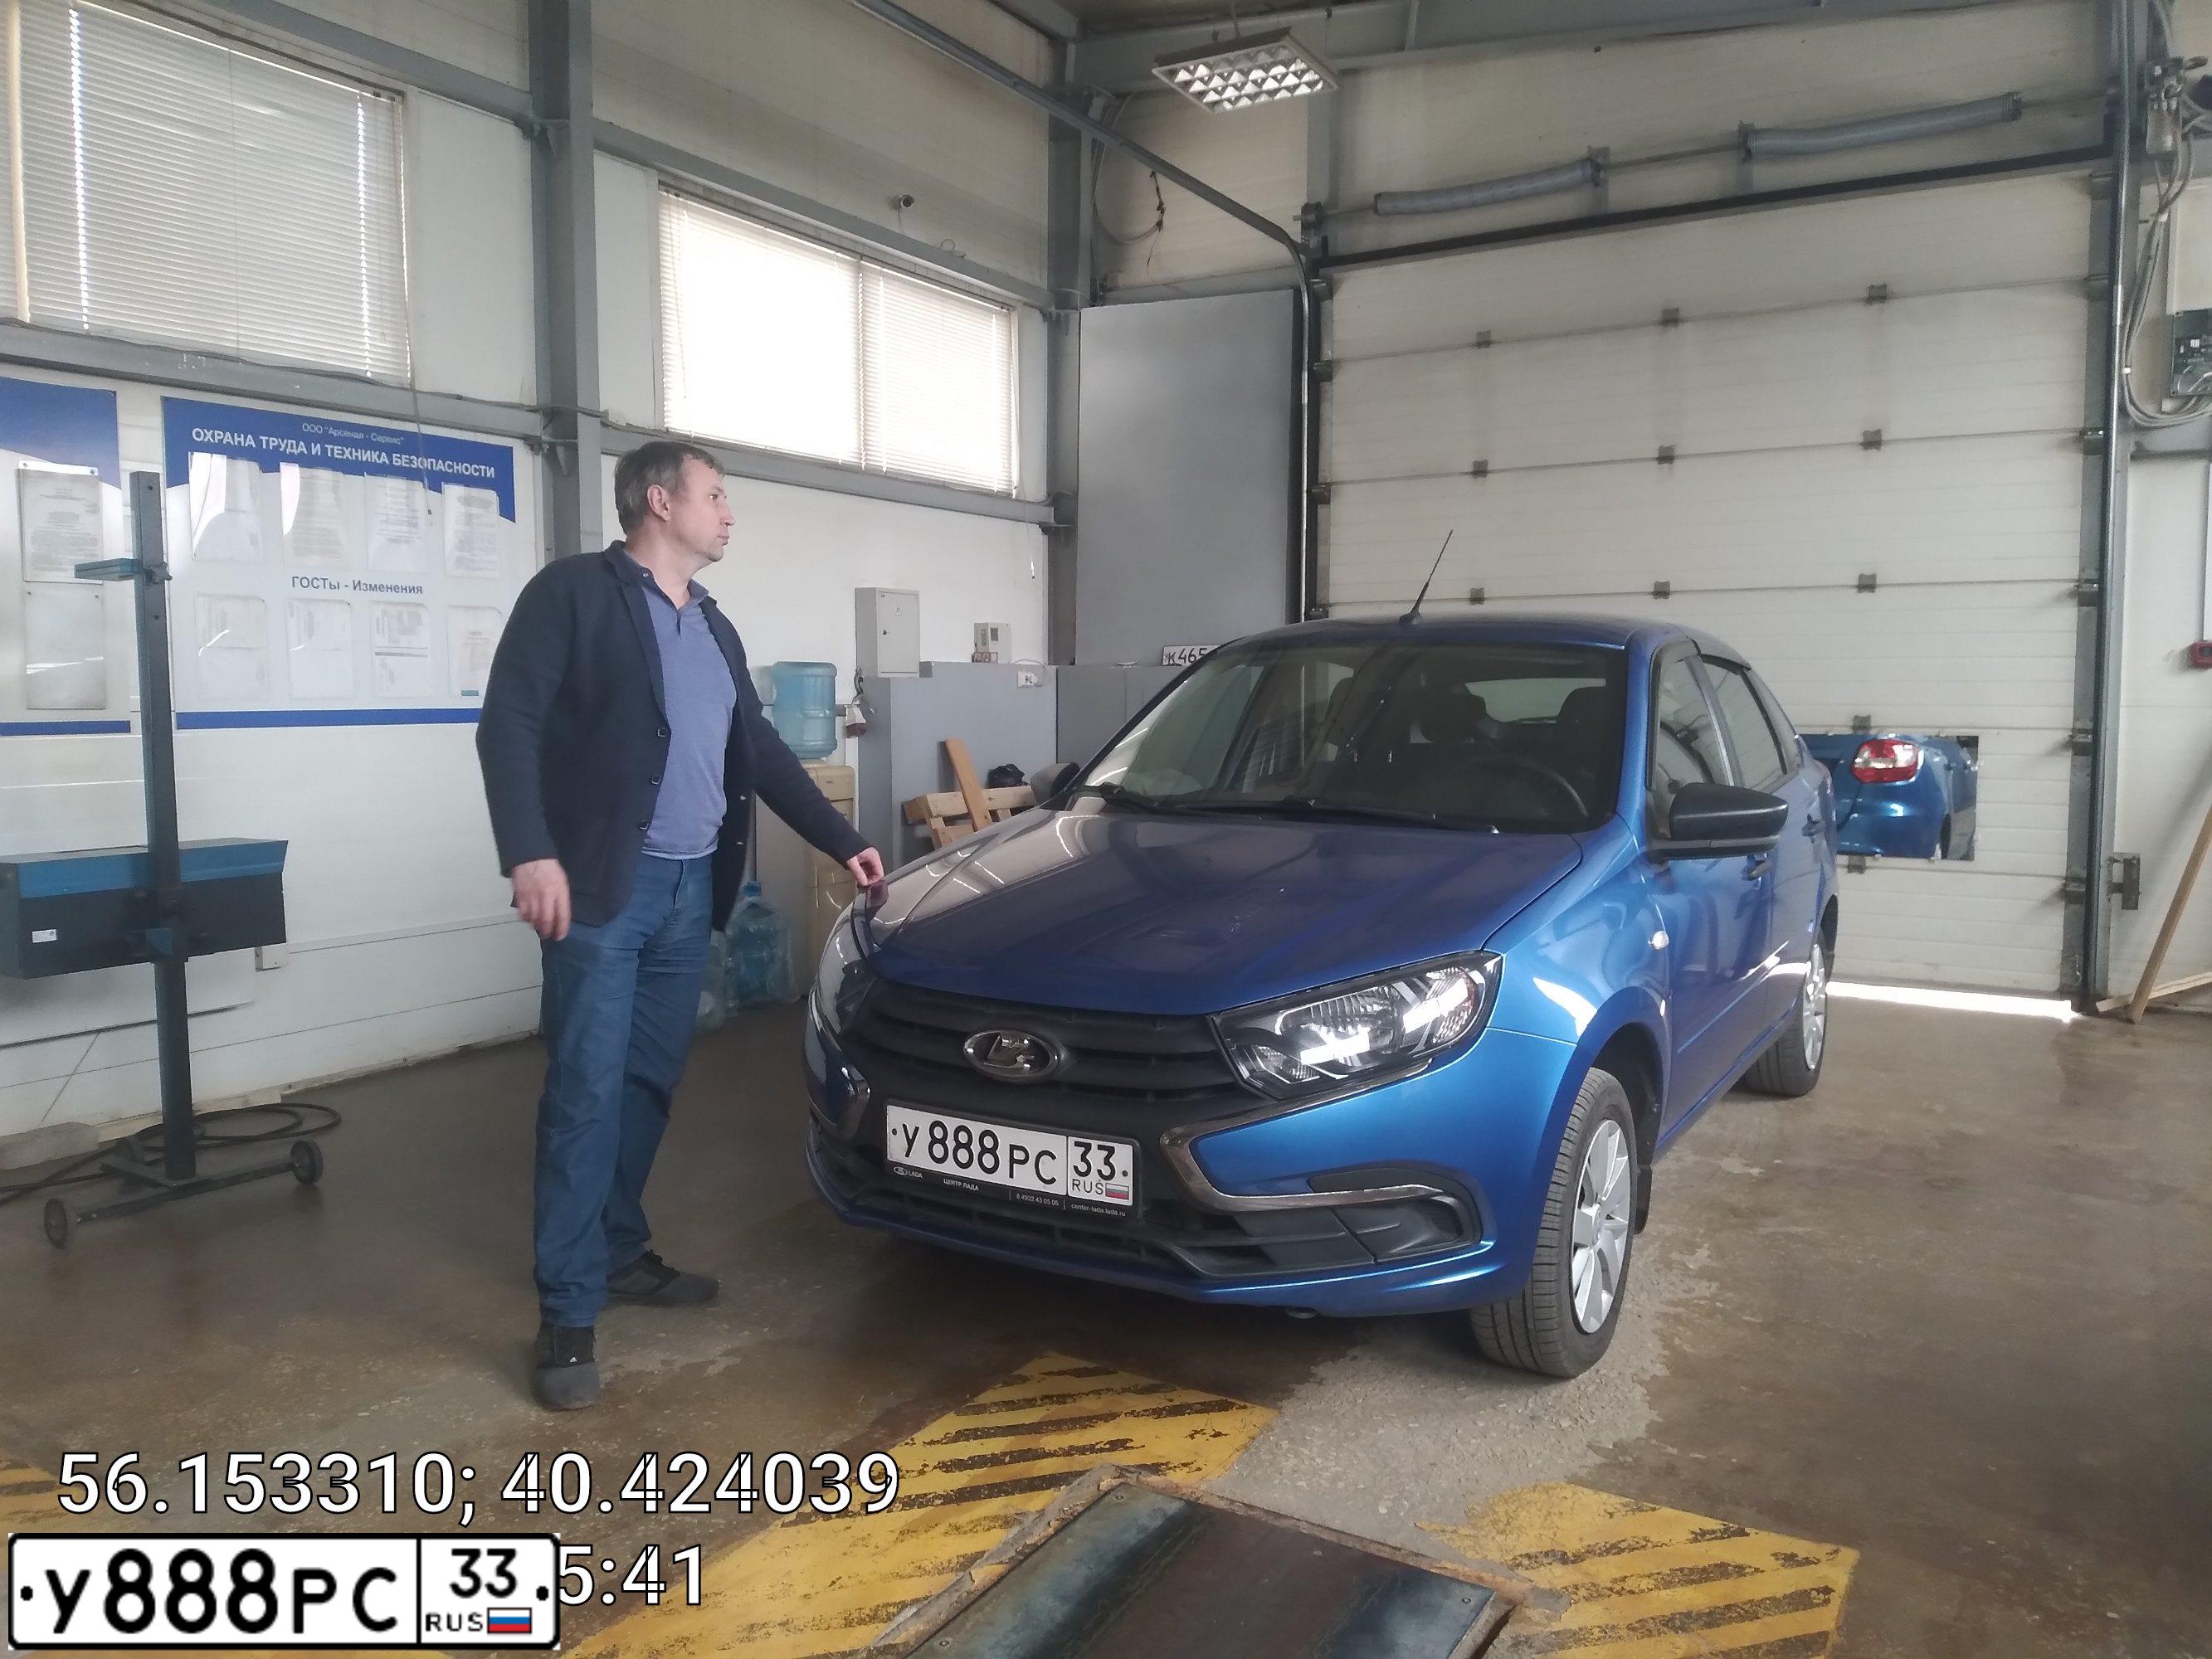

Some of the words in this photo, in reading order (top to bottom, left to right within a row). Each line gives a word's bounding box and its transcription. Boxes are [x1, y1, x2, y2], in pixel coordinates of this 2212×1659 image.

[302, 422, 323, 434] ООО
[192, 427, 256, 448] ОХРАНА
[259, 435, 308, 455] ТРУДА
[311, 442, 321, 456] И
[324, 444, 388, 465] ТЕХНИКА
[392, 453, 495, 479] БЕЗОПАСНОСТИ
[291, 576, 340, 590] ГОСТы
[353, 580, 423, 595] Изменения
[1073, 1141, 1116, 1181] 33
[909, 1170, 923, 1179] LADA
[943, 1178, 962, 1187] ЦЕНТР
[962, 1182, 979, 1191] ЛАДА
[1072, 1179, 1104, 1195] RUS
